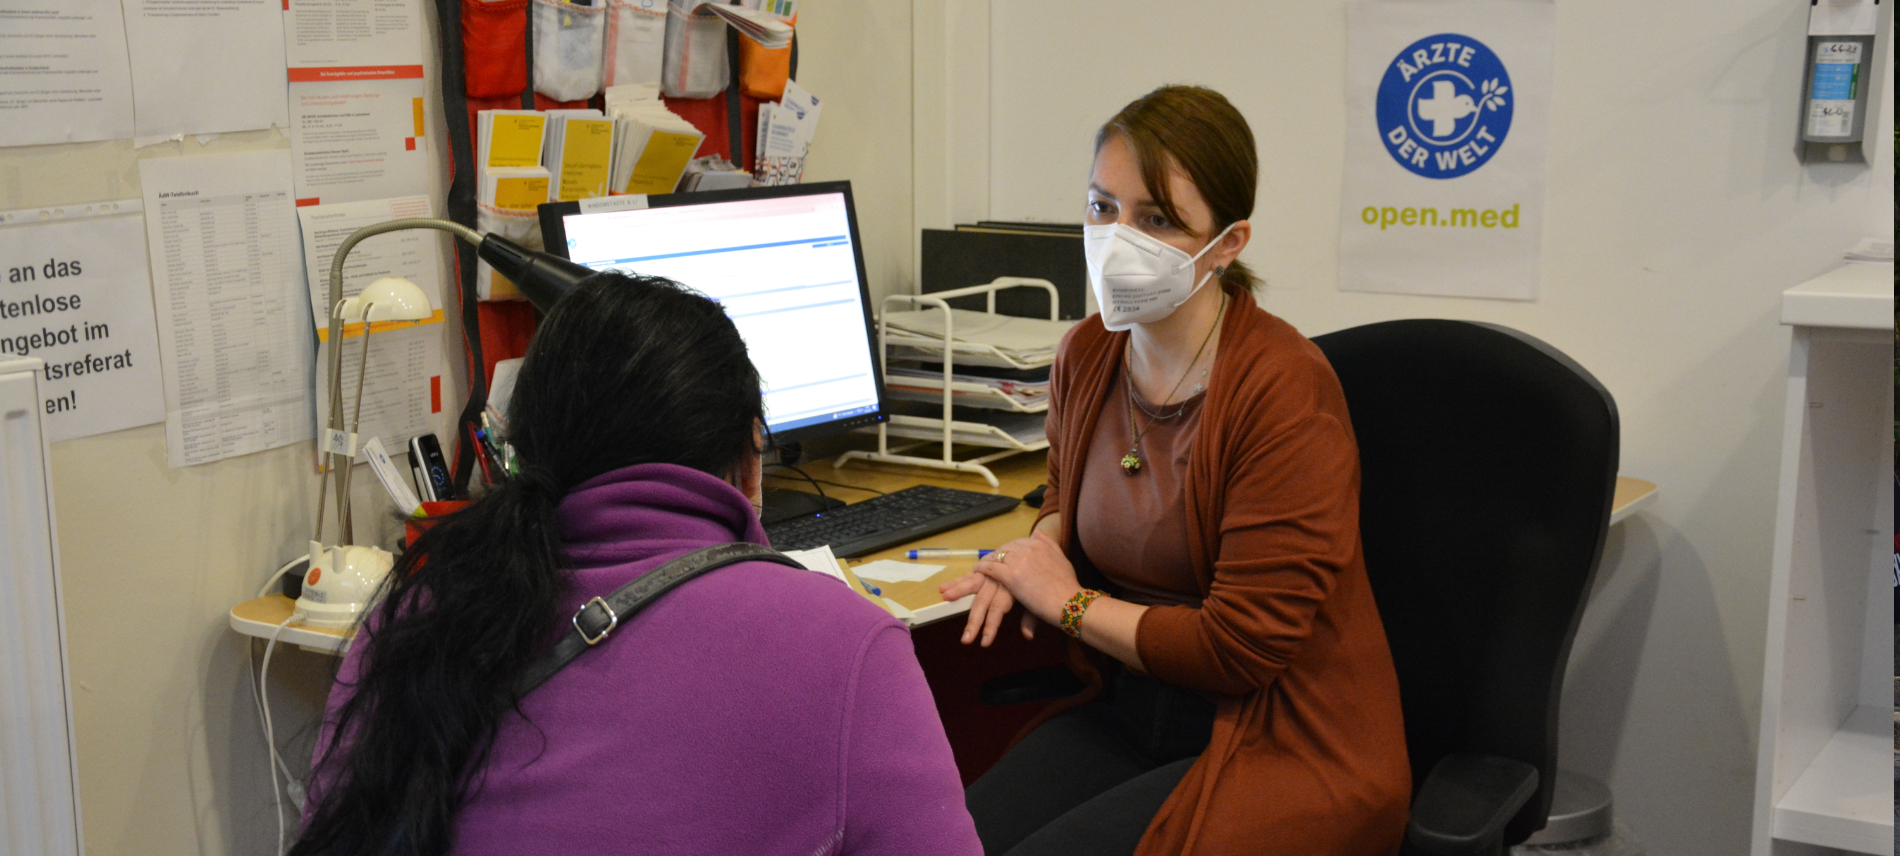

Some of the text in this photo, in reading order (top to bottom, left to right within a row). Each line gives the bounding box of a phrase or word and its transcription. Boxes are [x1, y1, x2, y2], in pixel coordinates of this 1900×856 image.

[1397, 42, 1476, 82] ÄRZTE
[1387, 125, 1496, 171] DER WELT
[587, 200, 625, 209] WINDOWSTASTE
[1361, 203, 1520, 231] open.med
[9, 266, 36, 283] an
[43, 258, 82, 279] das
[0, 294, 81, 319] tenlose
[1123, 305, 1140, 313] 2834
[0, 321, 109, 356] ngebot im
[44, 349, 133, 381] tsreferat
[45, 390, 77, 414] en!
